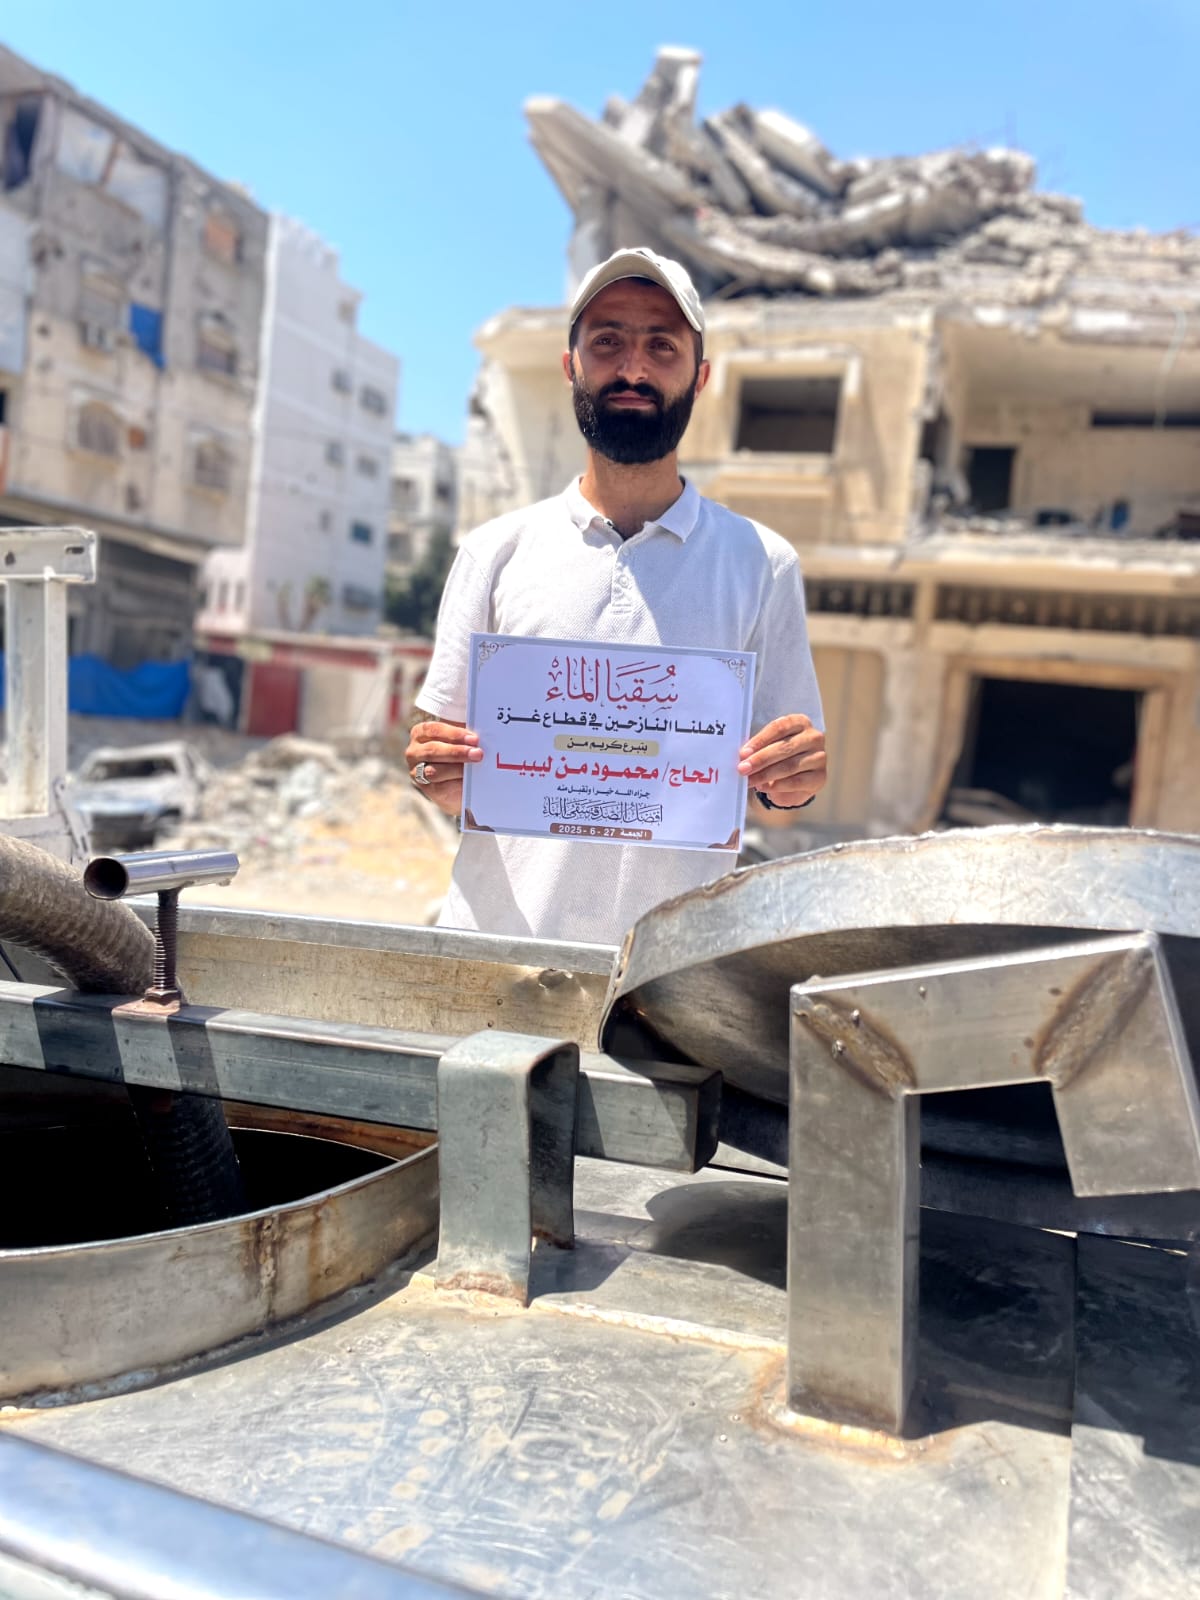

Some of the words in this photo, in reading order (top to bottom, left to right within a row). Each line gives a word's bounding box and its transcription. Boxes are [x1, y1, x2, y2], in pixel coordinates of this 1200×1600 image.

[497, 707, 541, 725] غزة
[542, 711, 587, 728] قطاع
[588, 712, 603, 731] في
[605, 715, 672, 733] النازحين
[566, 737, 588, 749] من
[590, 740, 622, 751] كريم
[622, 742, 648, 754] بتبرع
[496, 752, 553, 777] ليبيا
[555, 756, 588, 779] من
[591, 762, 659, 781] محمود
[614, 788, 633, 796] الله
[620, 828, 648, 840] الجمعة
